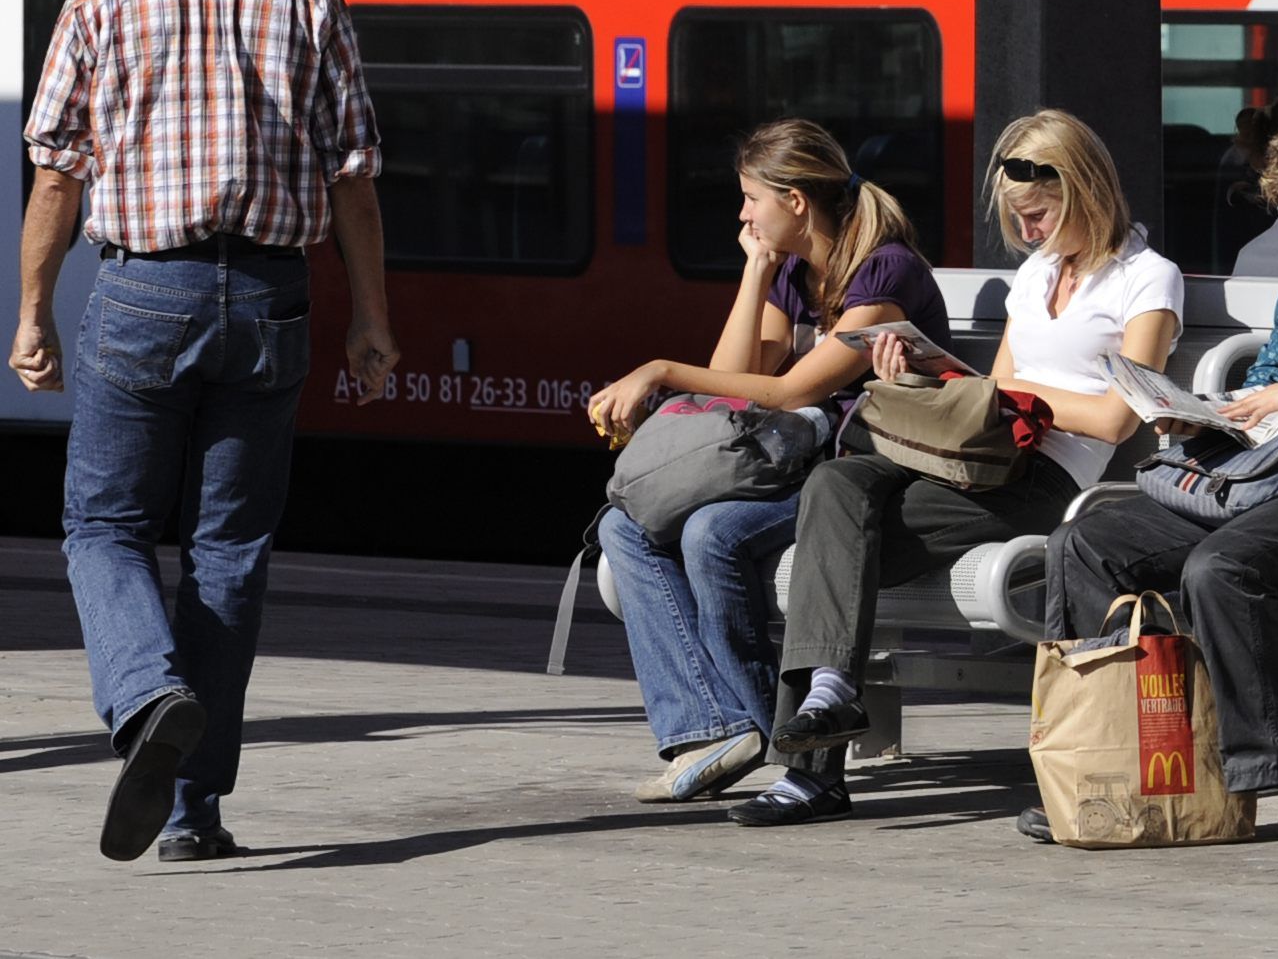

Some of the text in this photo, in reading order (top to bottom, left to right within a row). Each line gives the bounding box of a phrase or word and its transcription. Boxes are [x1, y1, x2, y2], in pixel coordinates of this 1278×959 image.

[405, 373, 431, 402] 50
[439, 375, 462, 403] 81
[470, 376, 527, 406] 26-33
